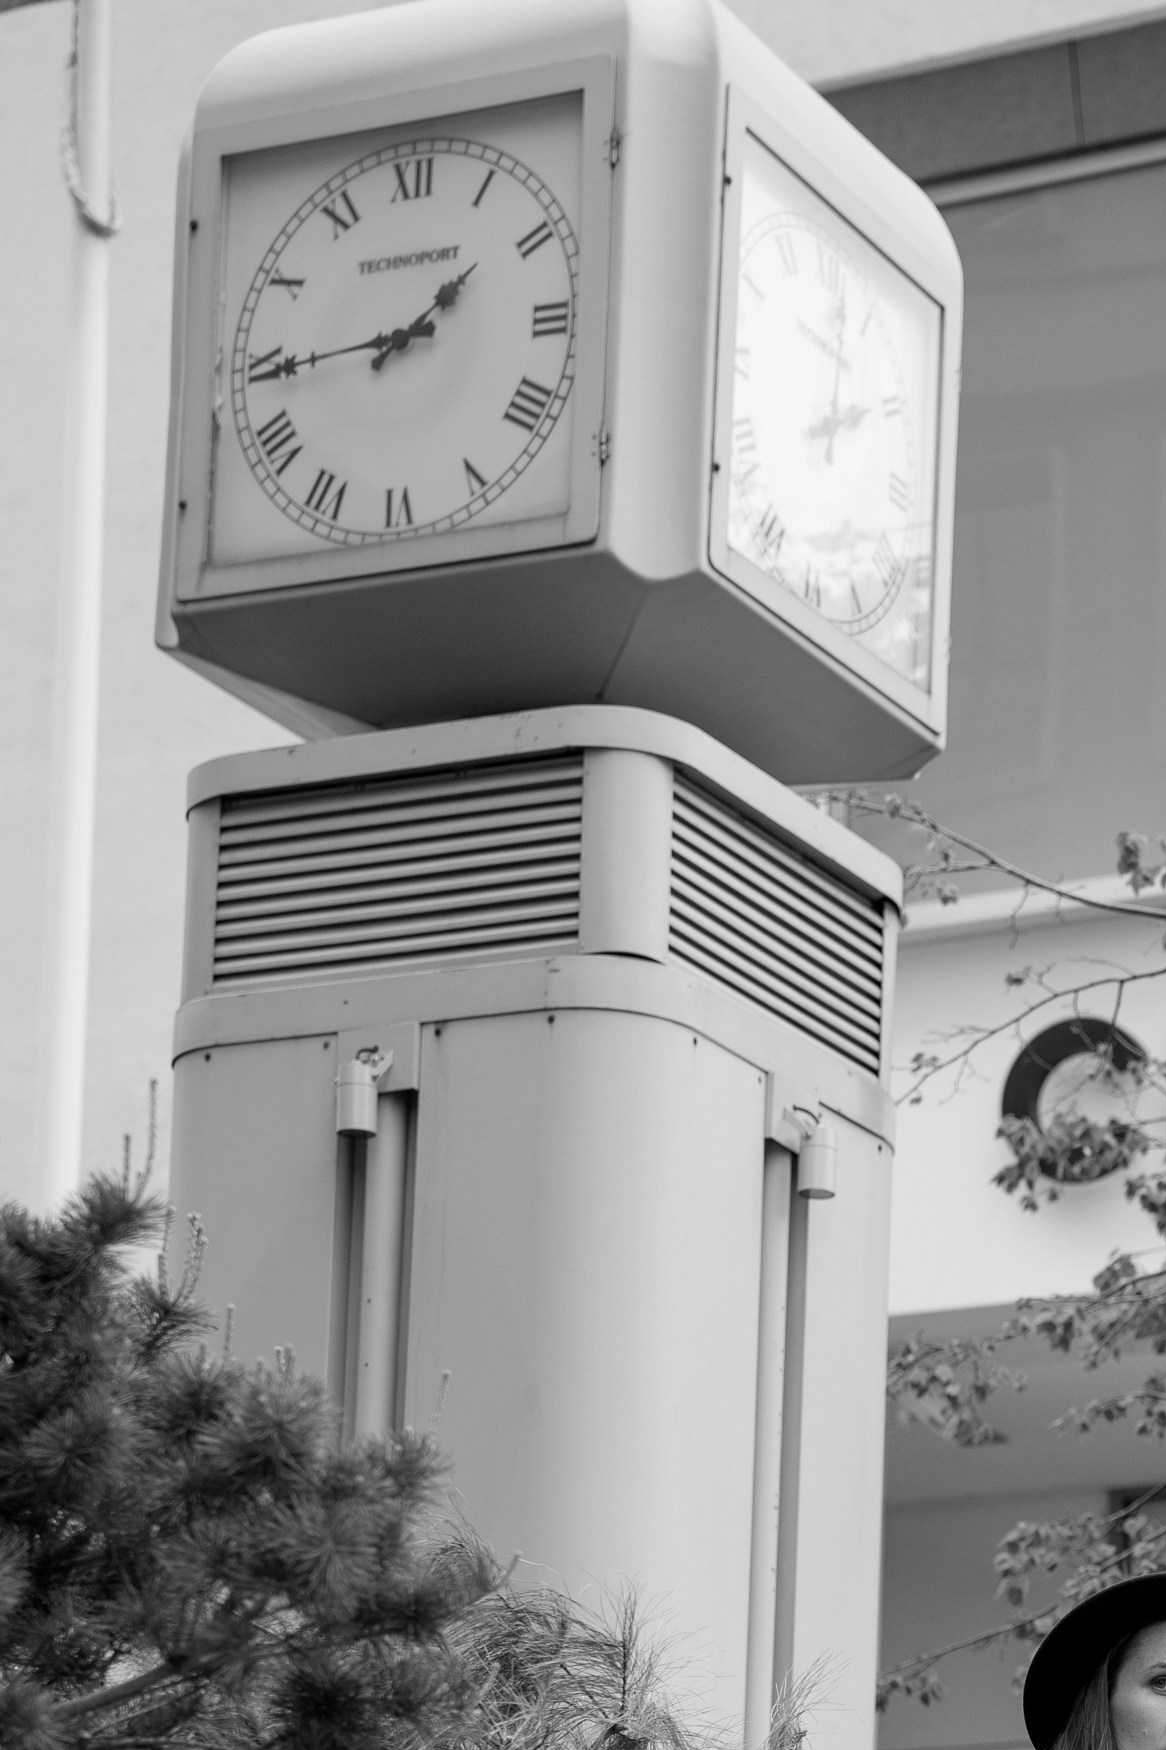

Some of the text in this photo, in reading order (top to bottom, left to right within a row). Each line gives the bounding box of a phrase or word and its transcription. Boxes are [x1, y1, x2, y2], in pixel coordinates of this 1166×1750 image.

[390, 157, 434, 203] XII
[472, 169, 495, 208] I
[320, 190, 361, 240] XI
[359, 245, 460, 275] TECHNOPORT
[515, 220, 555, 260] II
[268, 268, 305, 300] X
[532, 301, 569, 339] III
[503, 376, 553, 432] IIII
[256, 409, 303, 476] VIII
[304, 469, 348, 522] VII
[462, 456, 488, 496] V
[384, 485, 413, 528] VI
